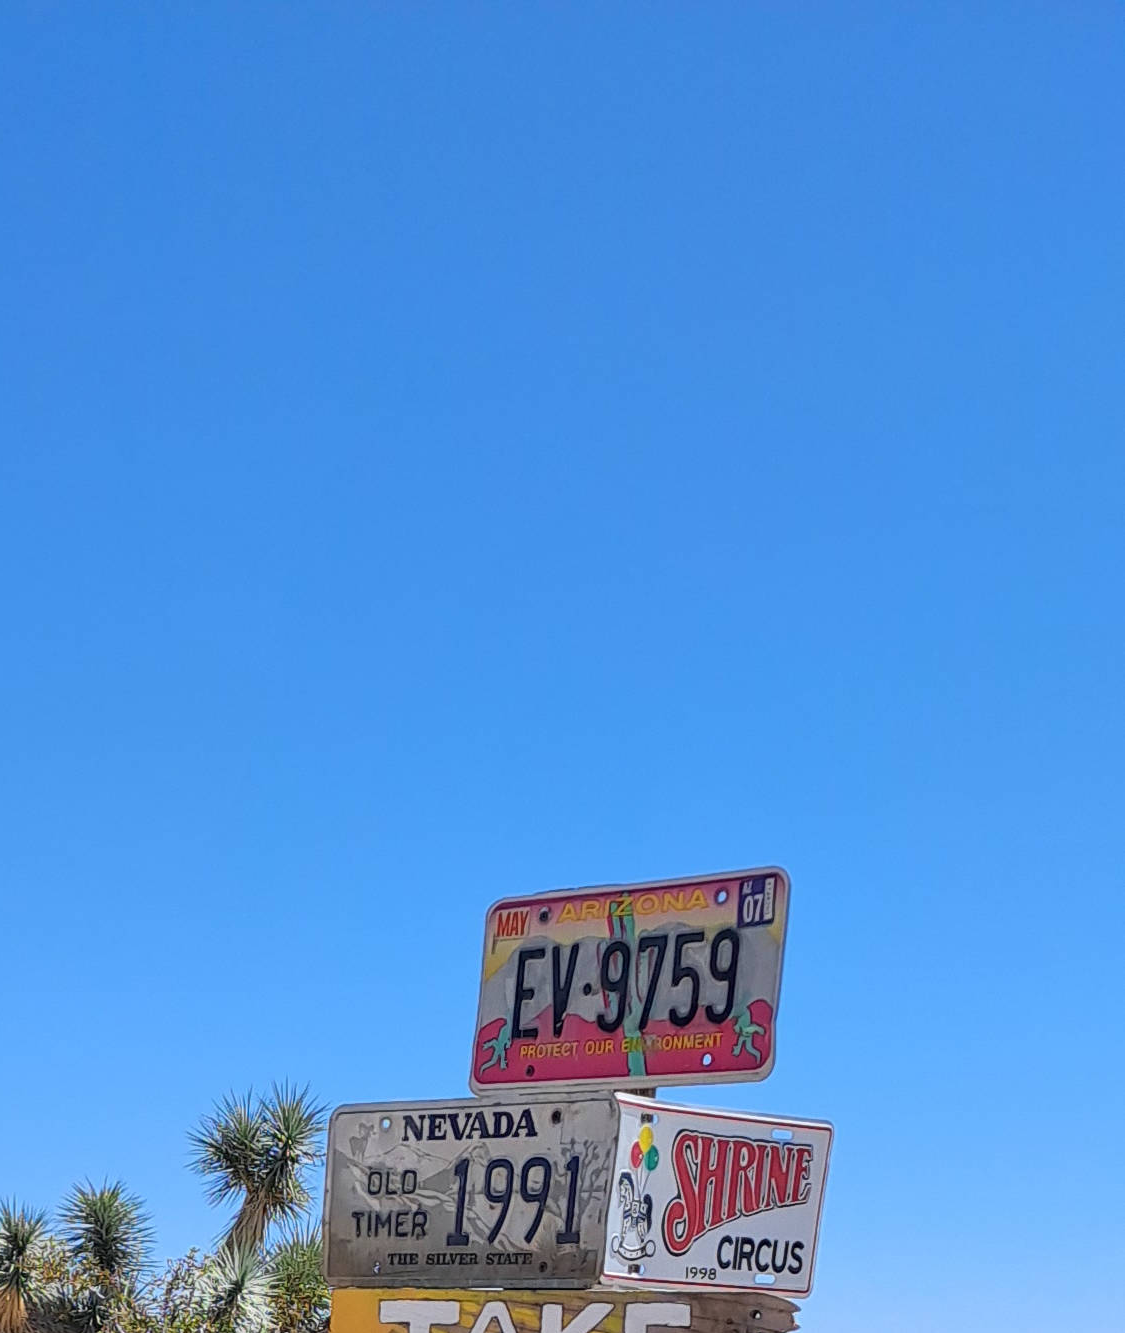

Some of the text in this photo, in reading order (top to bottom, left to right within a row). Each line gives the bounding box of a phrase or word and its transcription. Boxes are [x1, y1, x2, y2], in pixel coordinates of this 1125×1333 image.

[557, 889, 709, 923] ARIZONA
[743, 894, 764, 923] 07
[496, 911, 528, 937] MAY
[520, 1042, 578, 1059] PROTECT
[585, 1037, 615, 1054] OUR
[402, 1109, 538, 1141] NEVADA
[367, 1170, 418, 1195] OLD
[662, 1129, 813, 1257] SHRINE
[446, 1156, 581, 1246] 1991
[351, 1211, 428, 1240] TIMER
[388, 1252, 533, 1266] THE SILVER STATE
[716, 1235, 805, 1275] CIRCUS
[685, 1266, 717, 1280] 1998
